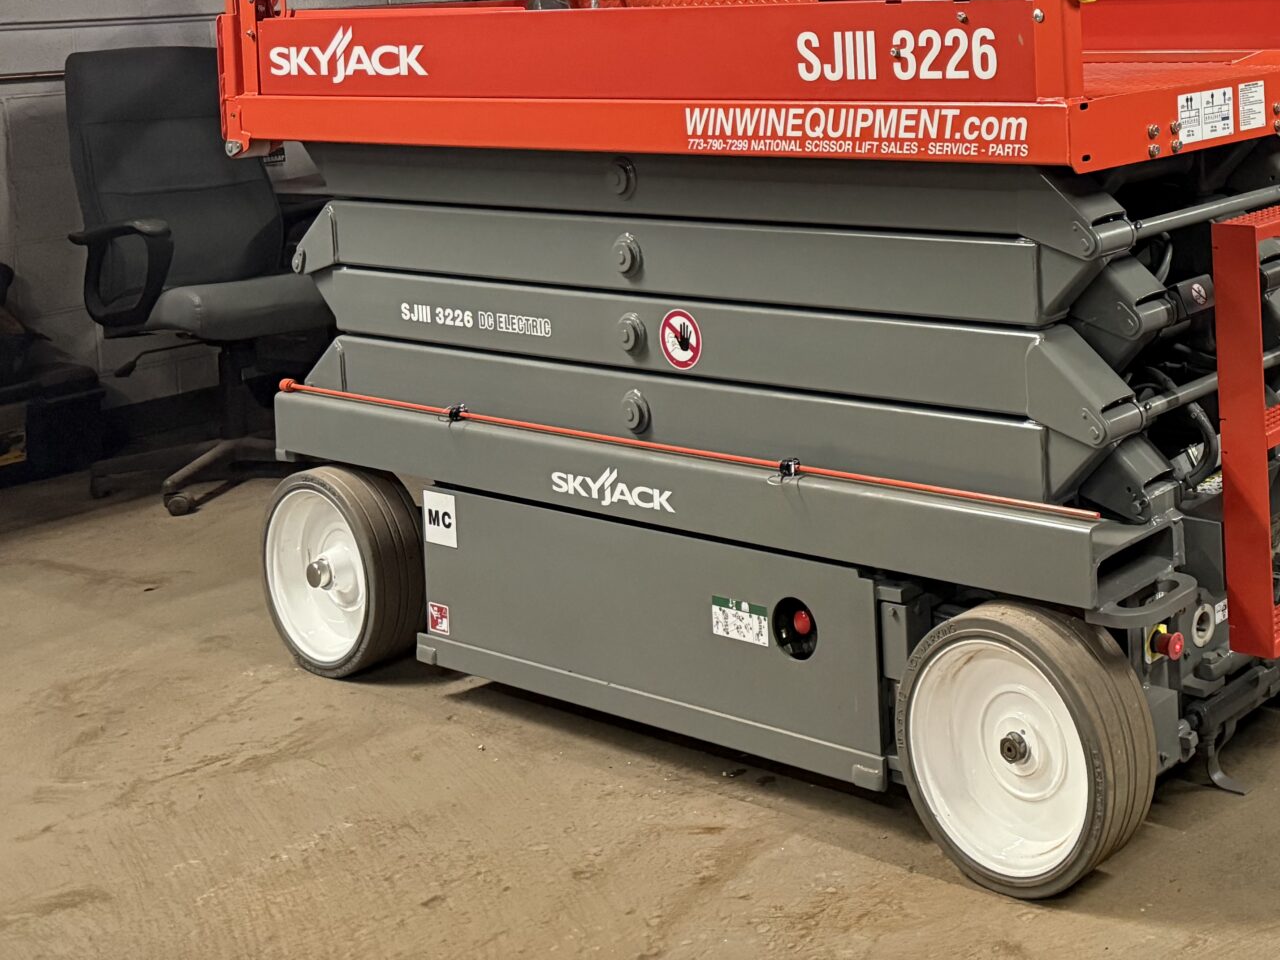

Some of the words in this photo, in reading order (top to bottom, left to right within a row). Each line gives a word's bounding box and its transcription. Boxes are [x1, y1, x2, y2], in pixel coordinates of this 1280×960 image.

[269, 25, 429, 83] SKYJACK
[797, 30, 877, 81] SJIII
[892, 27, 998, 80] 3226
[685, 107, 1028, 141] WINWINEQUIPMENT.com
[687, 138, 748, 151] 773-790-7299
[750, 139, 802, 152] NATIONAL
[804, 140, 853, 153] SCISSOR
[855, 141, 879, 154] LIFT
[880, 141, 919, 154] SALES
[927, 142, 979, 155] SERVICE
[988, 143, 1029, 157] PARTS
[435, 307, 474, 328] 3226
[478, 310, 494, 330] DC
[496, 313, 552, 337] ELECTRIC
[551, 467, 676, 513] SKYJACK
[428, 508, 452, 529] MC
